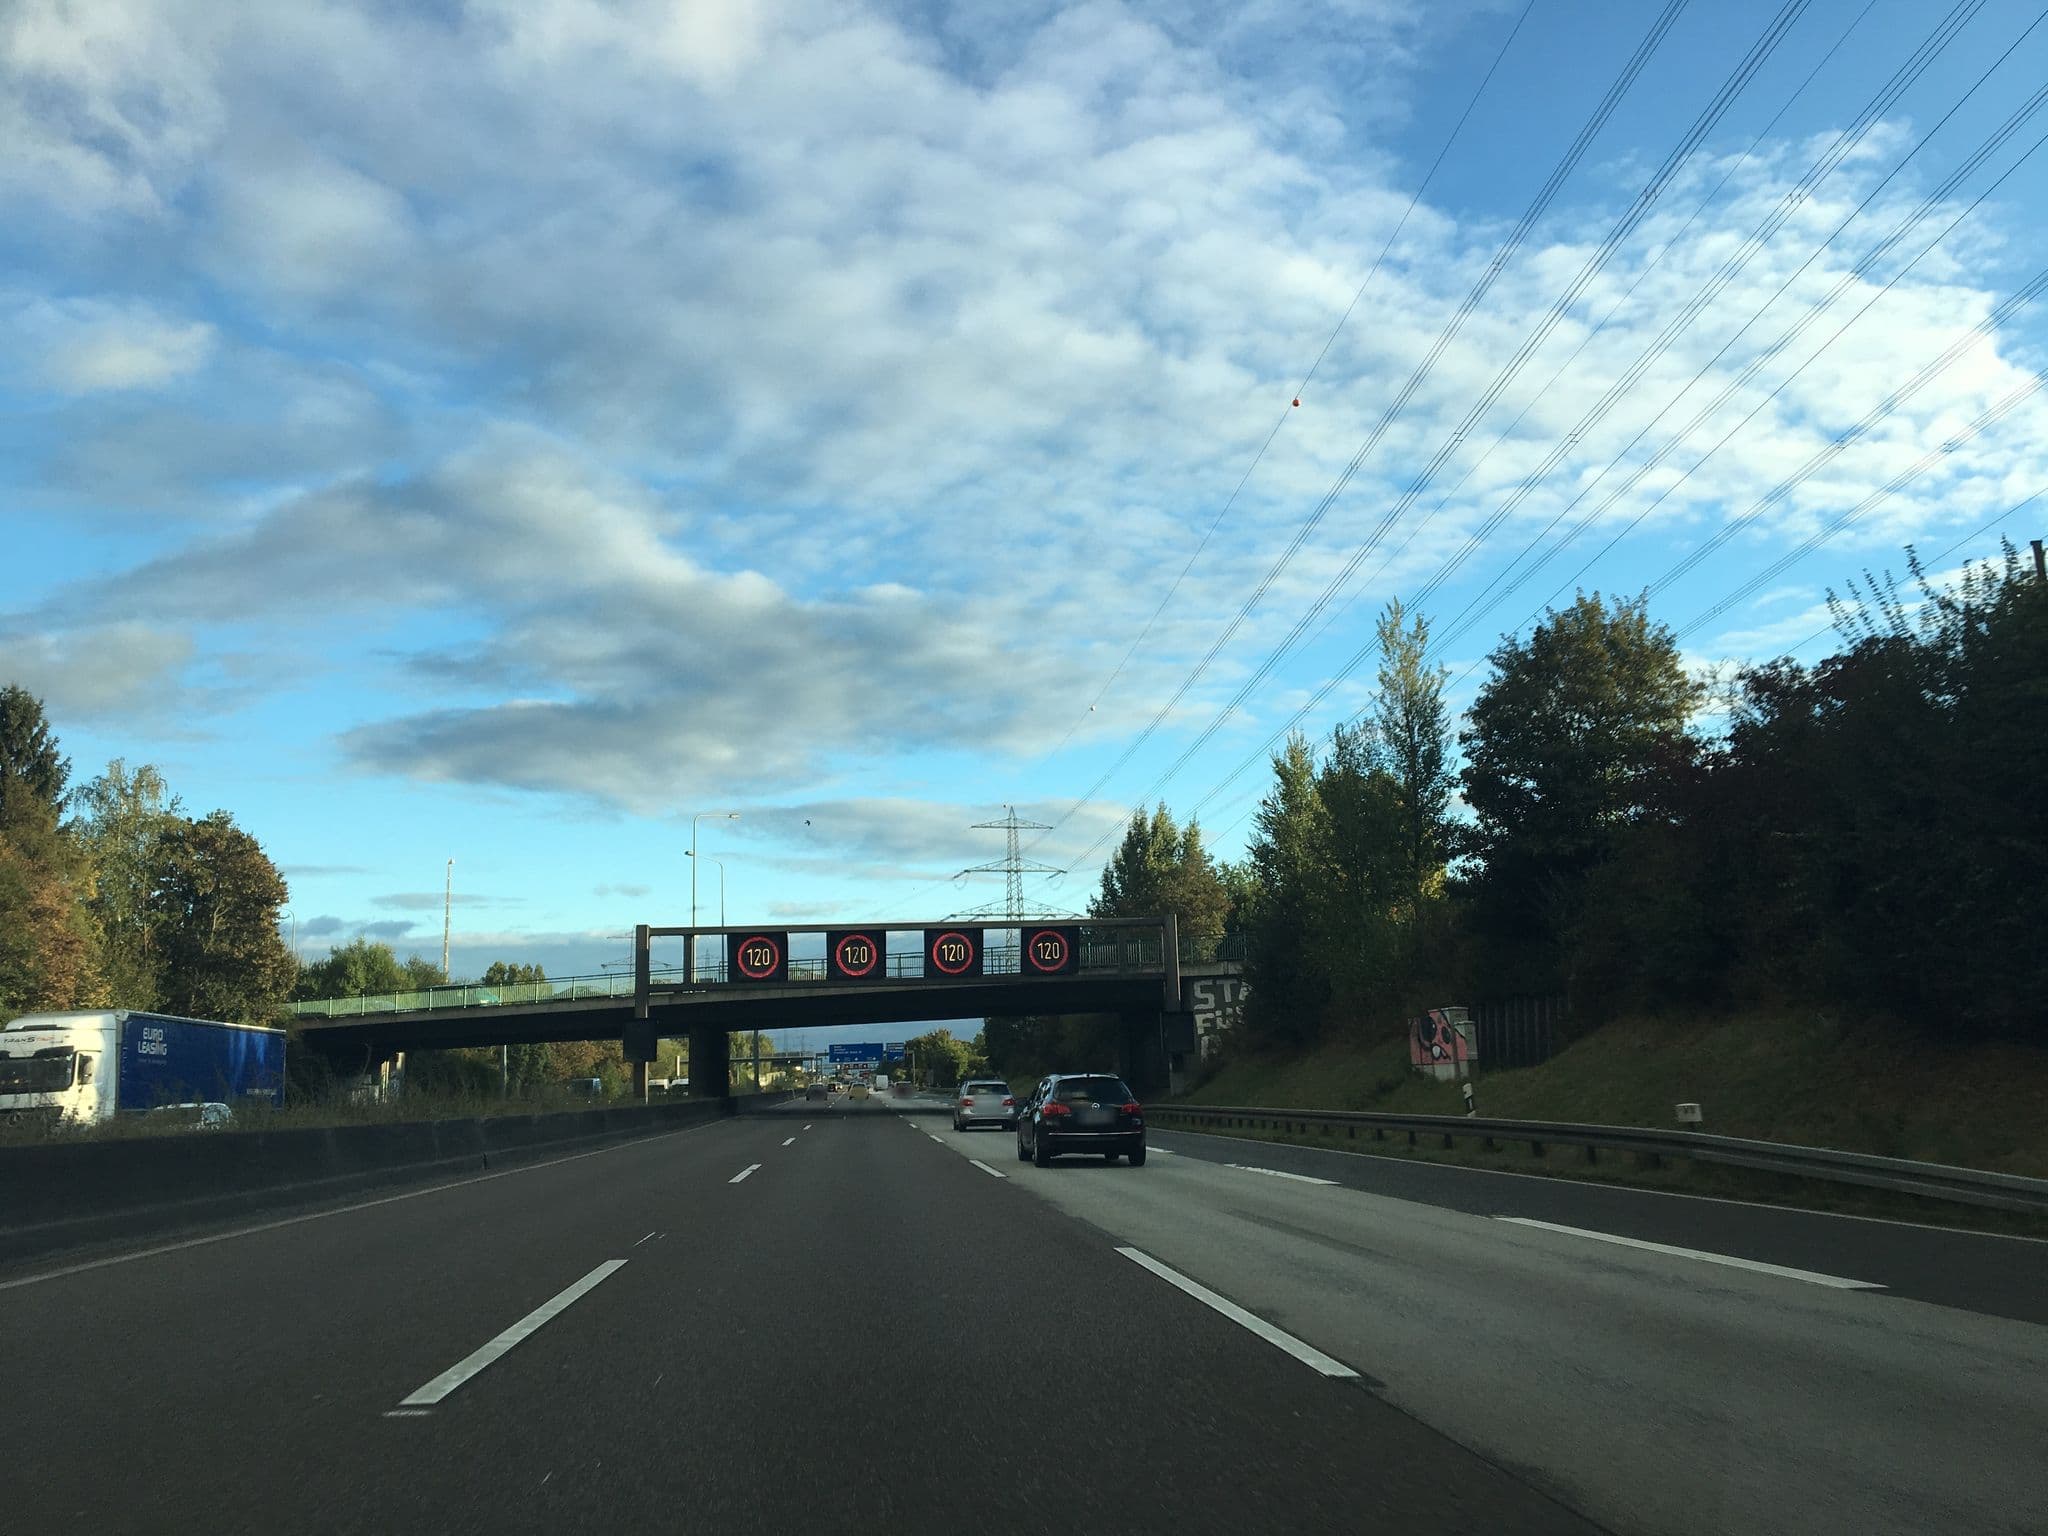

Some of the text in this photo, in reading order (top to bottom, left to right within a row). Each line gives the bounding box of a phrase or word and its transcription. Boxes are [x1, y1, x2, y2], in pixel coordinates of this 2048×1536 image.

[746, 948, 770, 966] 120
[845, 946, 869, 964] 120
[941, 944, 965, 962] 120
[1037, 942, 1061, 960] 120
[143, 1027, 164, 1041] EURO
[137, 1041, 168, 1056] LEASING
